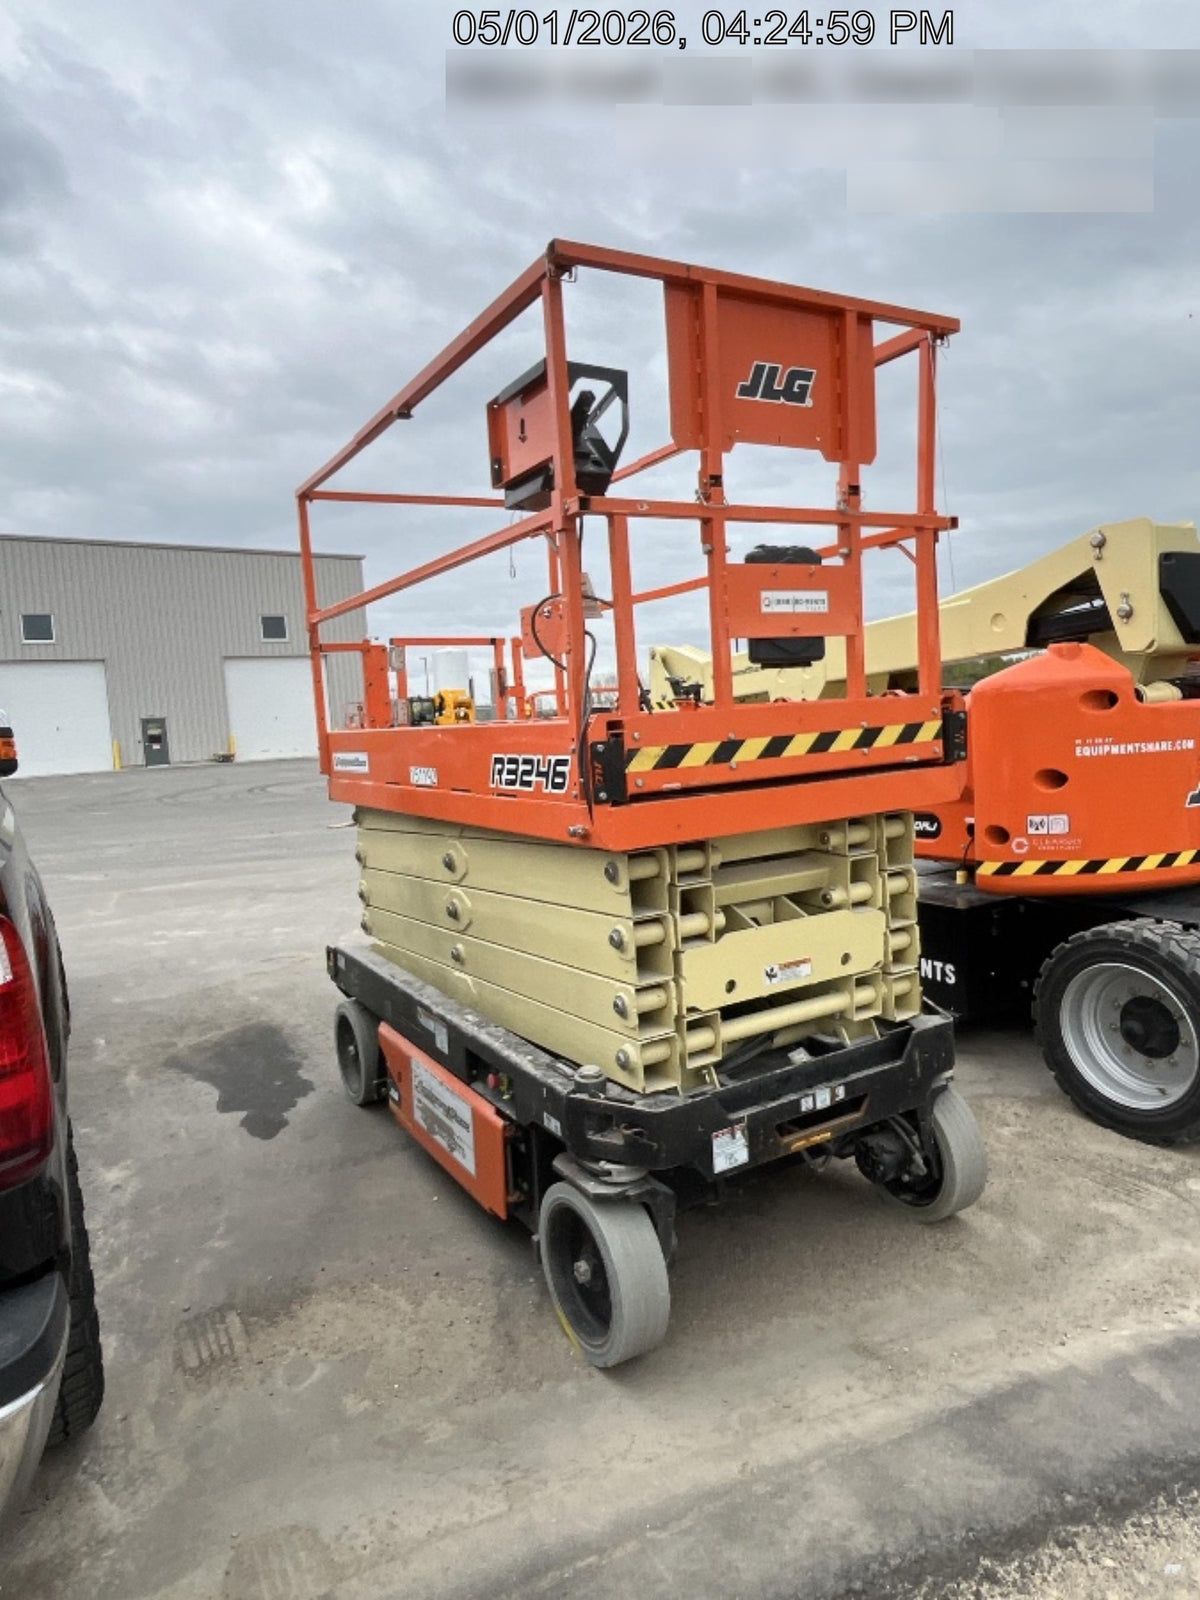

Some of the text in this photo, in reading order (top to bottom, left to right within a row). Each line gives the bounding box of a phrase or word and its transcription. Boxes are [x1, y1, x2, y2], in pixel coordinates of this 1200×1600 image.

[735, 361, 816, 406] JLG
[1074, 739, 1195, 757] EQUIPMENTSHARE.COM
[490, 754, 571, 793] R3246
[920, 957, 956, 985] NTS
